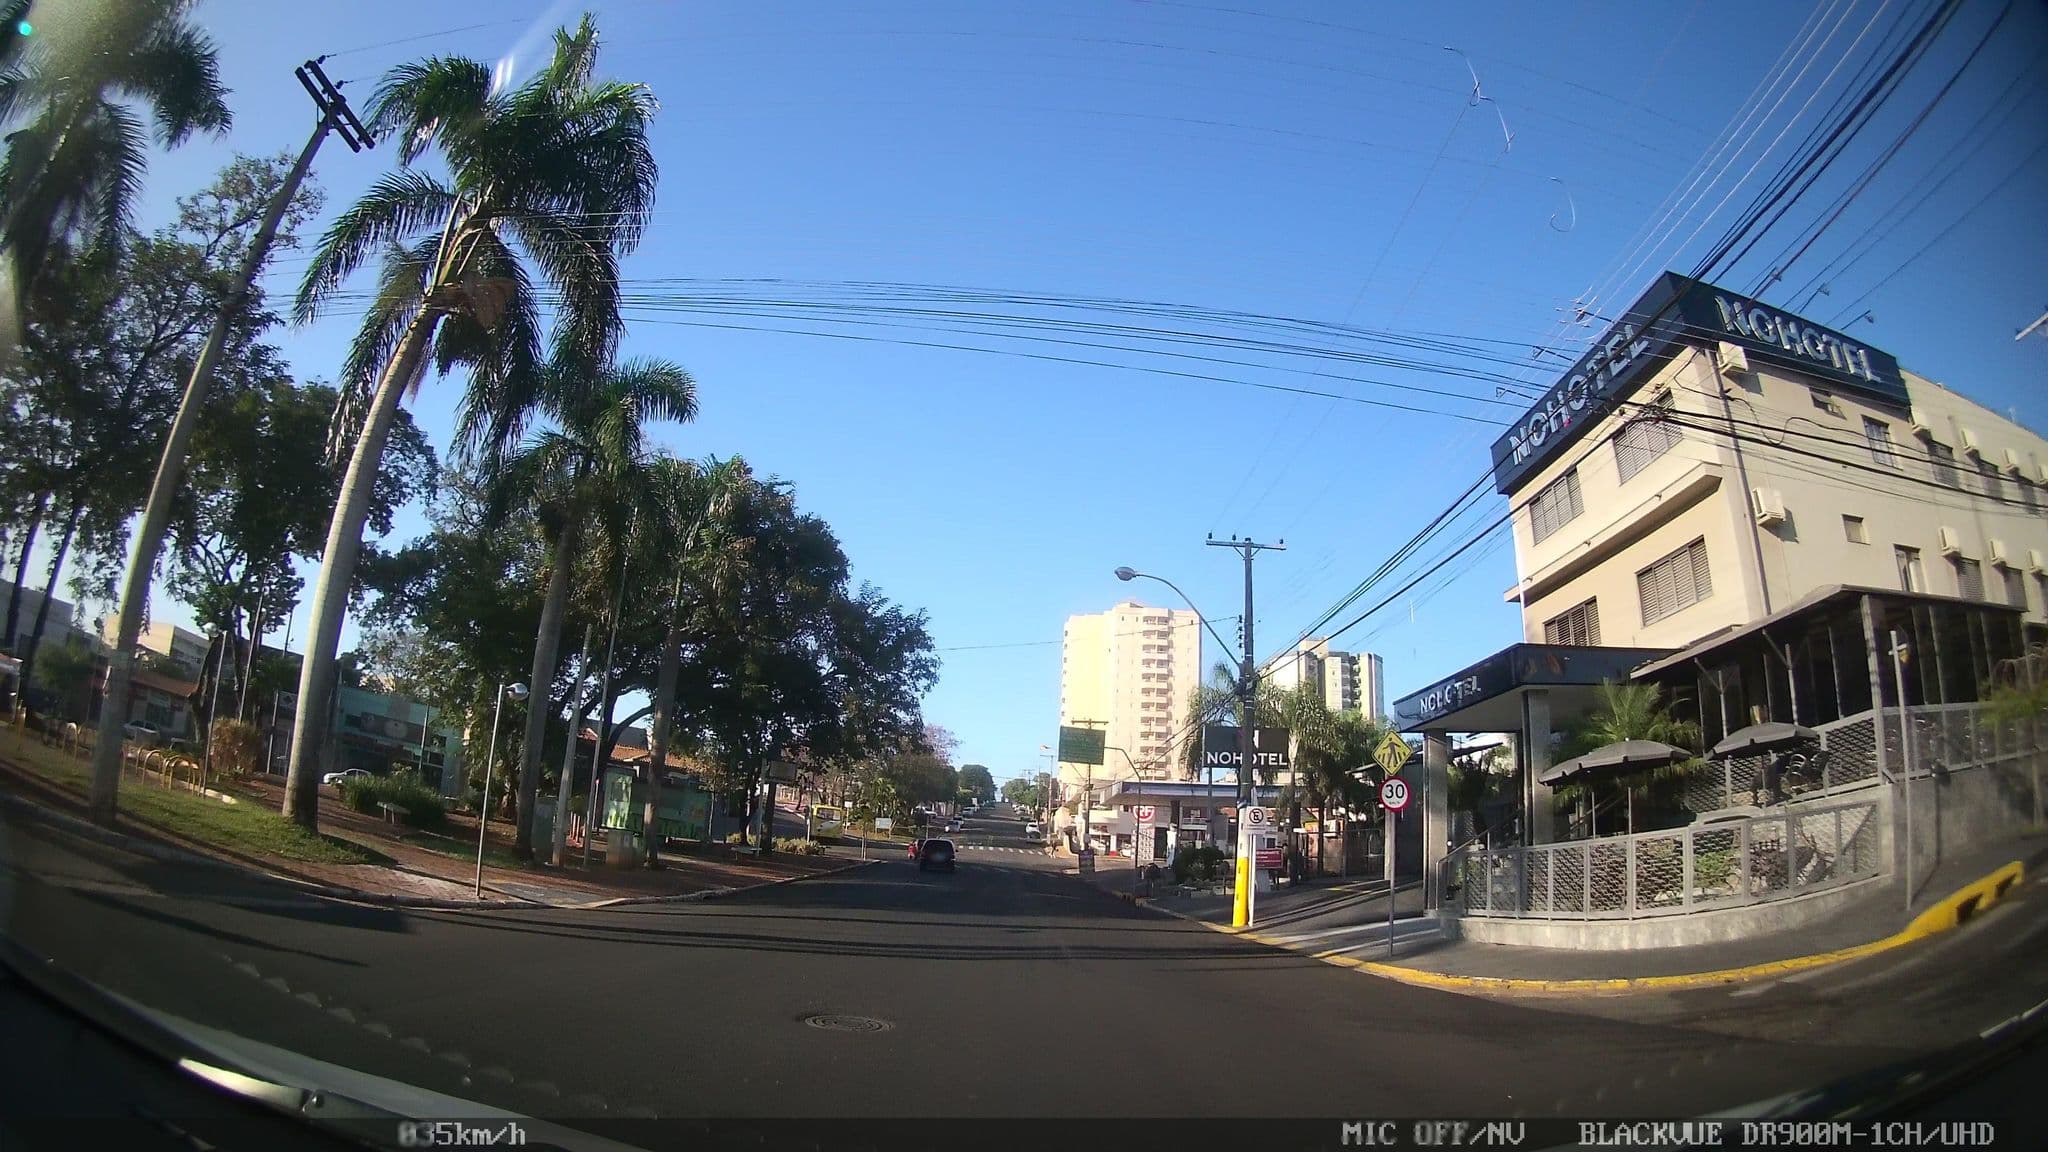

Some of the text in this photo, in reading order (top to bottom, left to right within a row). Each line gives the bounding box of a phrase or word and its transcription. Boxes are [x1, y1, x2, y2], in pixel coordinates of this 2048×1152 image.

[1714, 295, 1882, 383] NOHOTEL
[1509, 324, 1650, 466] NOHOTEL
[1385, 783, 1405, 799] 30
